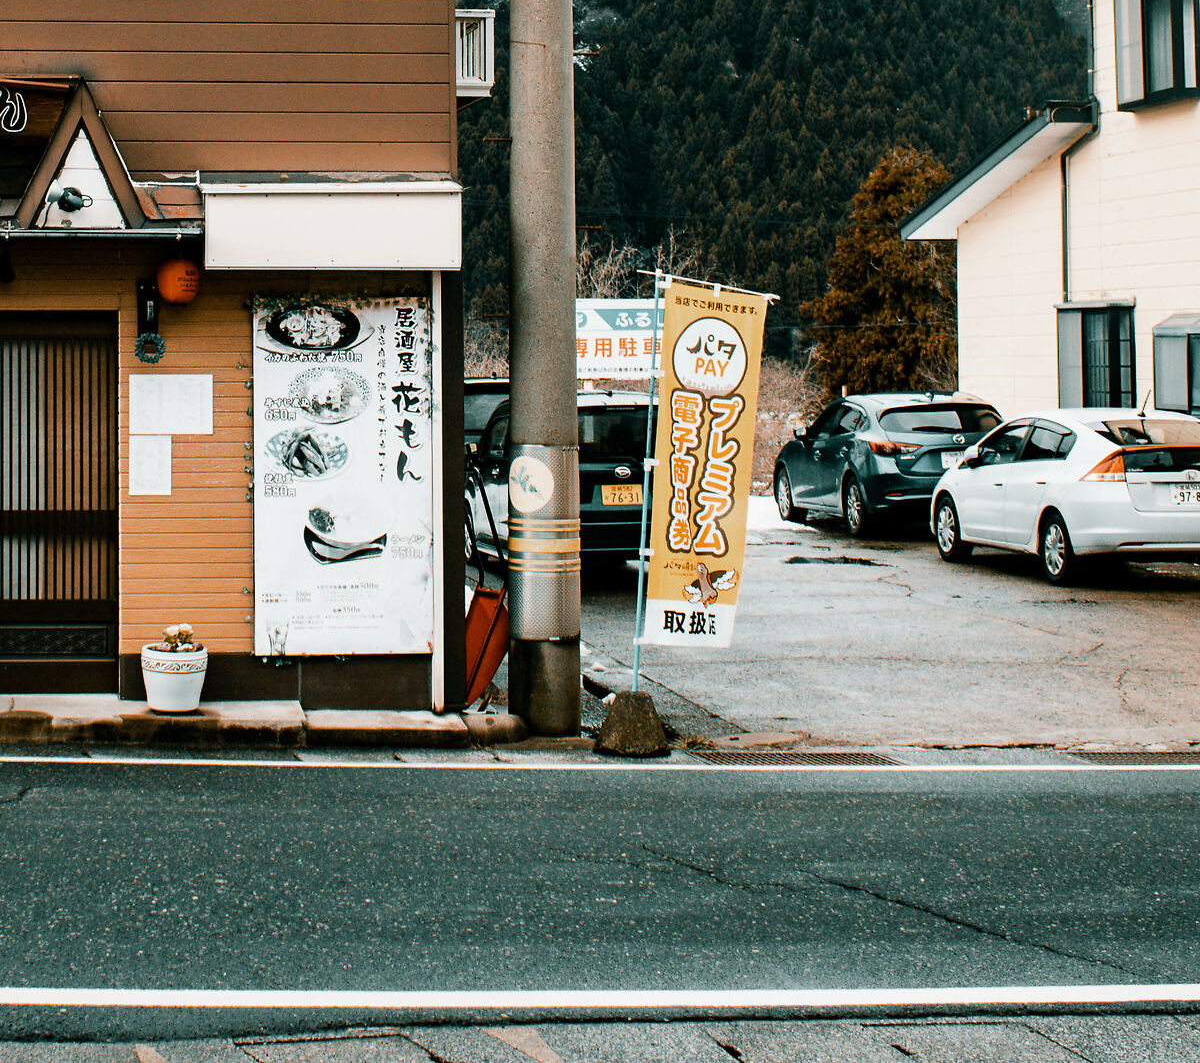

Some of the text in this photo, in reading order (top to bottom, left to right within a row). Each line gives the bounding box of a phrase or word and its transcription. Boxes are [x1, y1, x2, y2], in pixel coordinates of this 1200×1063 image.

[675, 295, 757, 315] 当店でご利用できます。
[331, 350, 363, 363] 750円
[686, 334, 737, 360] パタ
[694, 357, 730, 377] PAY
[391, 307, 423, 482] 居酒屋 花もん
[265, 409, 297, 421] 650円
[669, 392, 703, 552] 電子商品券
[694, 398, 744, 554] プレミアム
[264, 485, 297, 498] 580円
